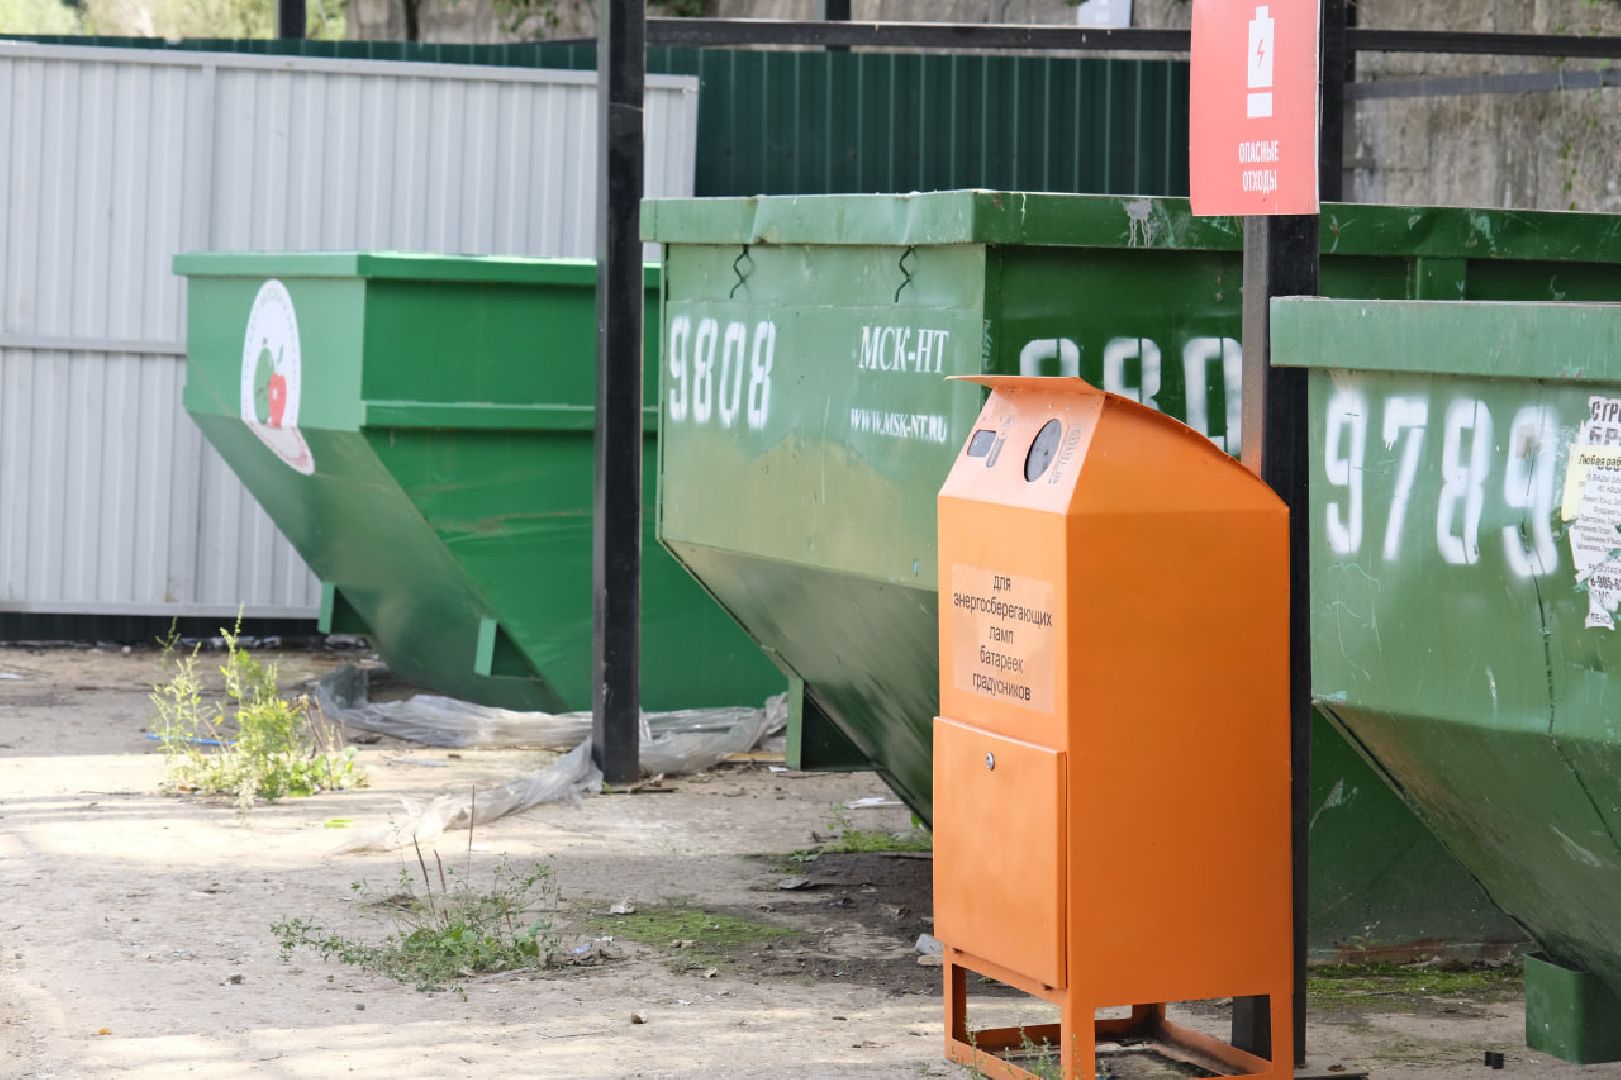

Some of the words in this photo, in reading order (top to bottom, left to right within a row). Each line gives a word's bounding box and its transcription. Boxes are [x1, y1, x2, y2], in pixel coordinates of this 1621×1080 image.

[1238, 140, 1280, 163] ОПАСНЫЕ
[1242, 169, 1277, 194] ОТХОДЫ
[857, 325, 950, 374] МСК-НТ
[668, 314, 777, 430] 9808
[1324, 389, 1559, 578] 9789
[993, 575, 1012, 592] для
[953, 592, 1053, 629] энергосберегающих
[989, 625, 1014, 645] ламп
[979, 645, 1024, 674] батареек
[972, 672, 1031, 701] градусников
